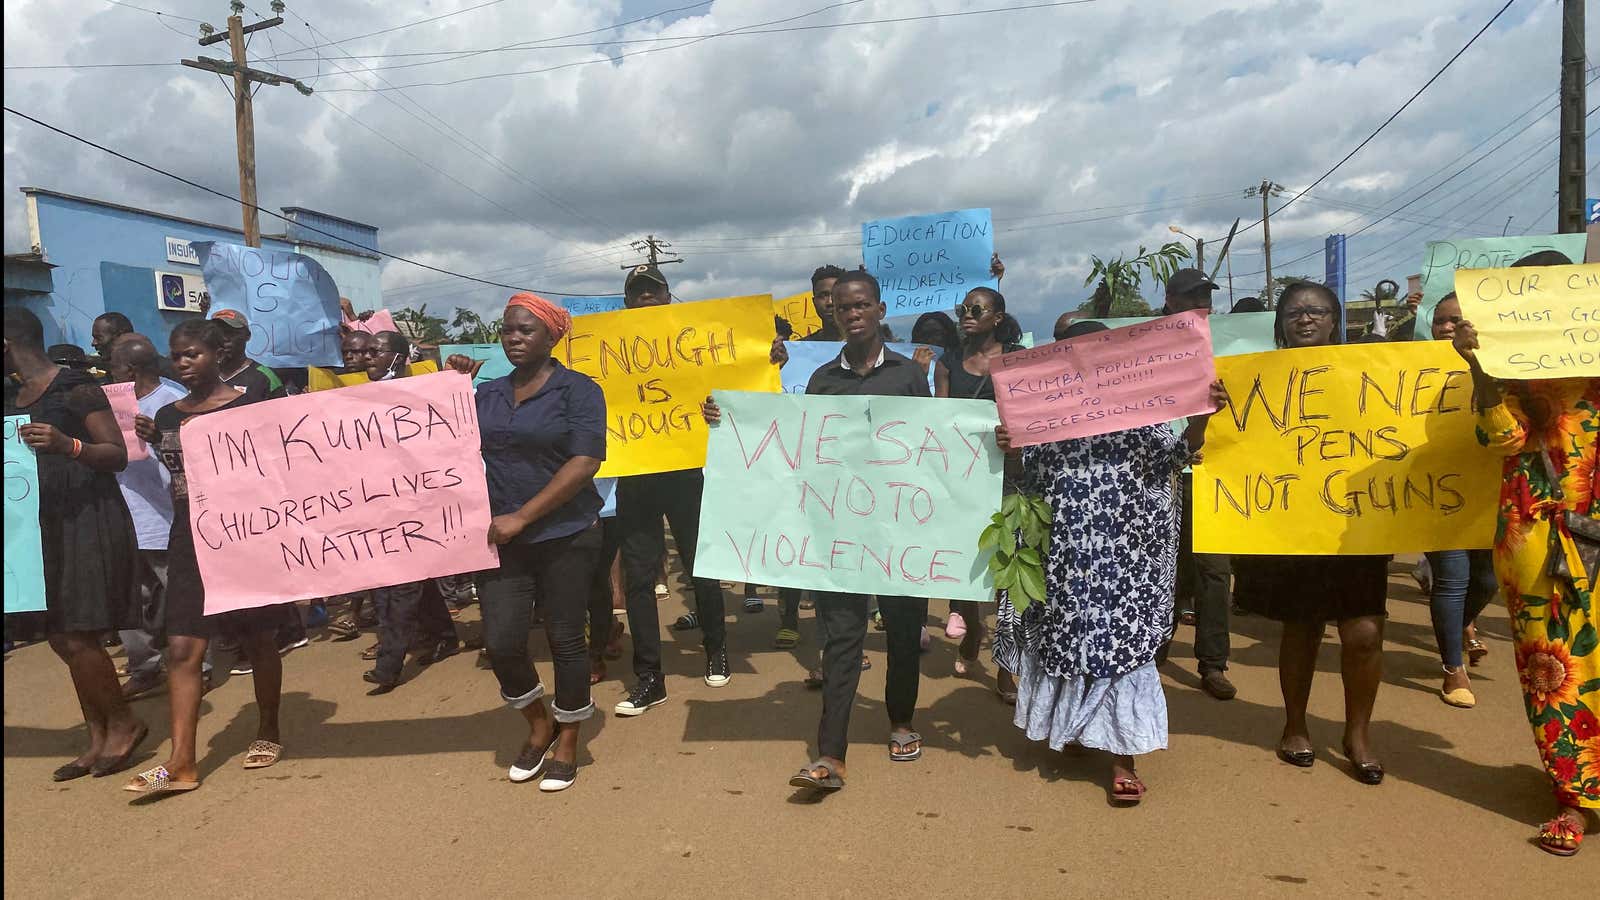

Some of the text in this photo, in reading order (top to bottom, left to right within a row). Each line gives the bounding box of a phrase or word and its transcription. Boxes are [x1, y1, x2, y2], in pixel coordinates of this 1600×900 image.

[168, 242, 200, 258] INSUR
[866, 220, 988, 248] EDUCATION
[876, 248, 950, 271] IS OUR
[188, 289, 208, 304] SA
[878, 266, 966, 293] HILDREN'S
[1476, 274, 1544, 302] OUR
[1497, 309, 1553, 323] MUST
[564, 327, 737, 382] ENOUGH
[1002, 318, 1196, 369] ENOUGH IS ENOUGH
[1562, 328, 1600, 344] TO
[1008, 350, 1200, 398] KUMBA POPULATION
[1507, 353, 1600, 372] SCHO
[637, 378, 672, 405] IS
[1080, 397, 1101, 407] TO
[1219, 366, 1477, 433] WE NEE
[606, 401, 704, 444] NOUG
[1026, 395, 1175, 436] SECESSIONISTS
[207, 428, 265, 478] I'M
[727, 410, 988, 480] WE SAY
[1281, 425, 1410, 466] PENS
[361, 468, 463, 503] LIVES
[799, 474, 936, 526] NO TO
[1214, 469, 1466, 520] NOT GUNS
[725, 529, 963, 587] VIOLENCE
